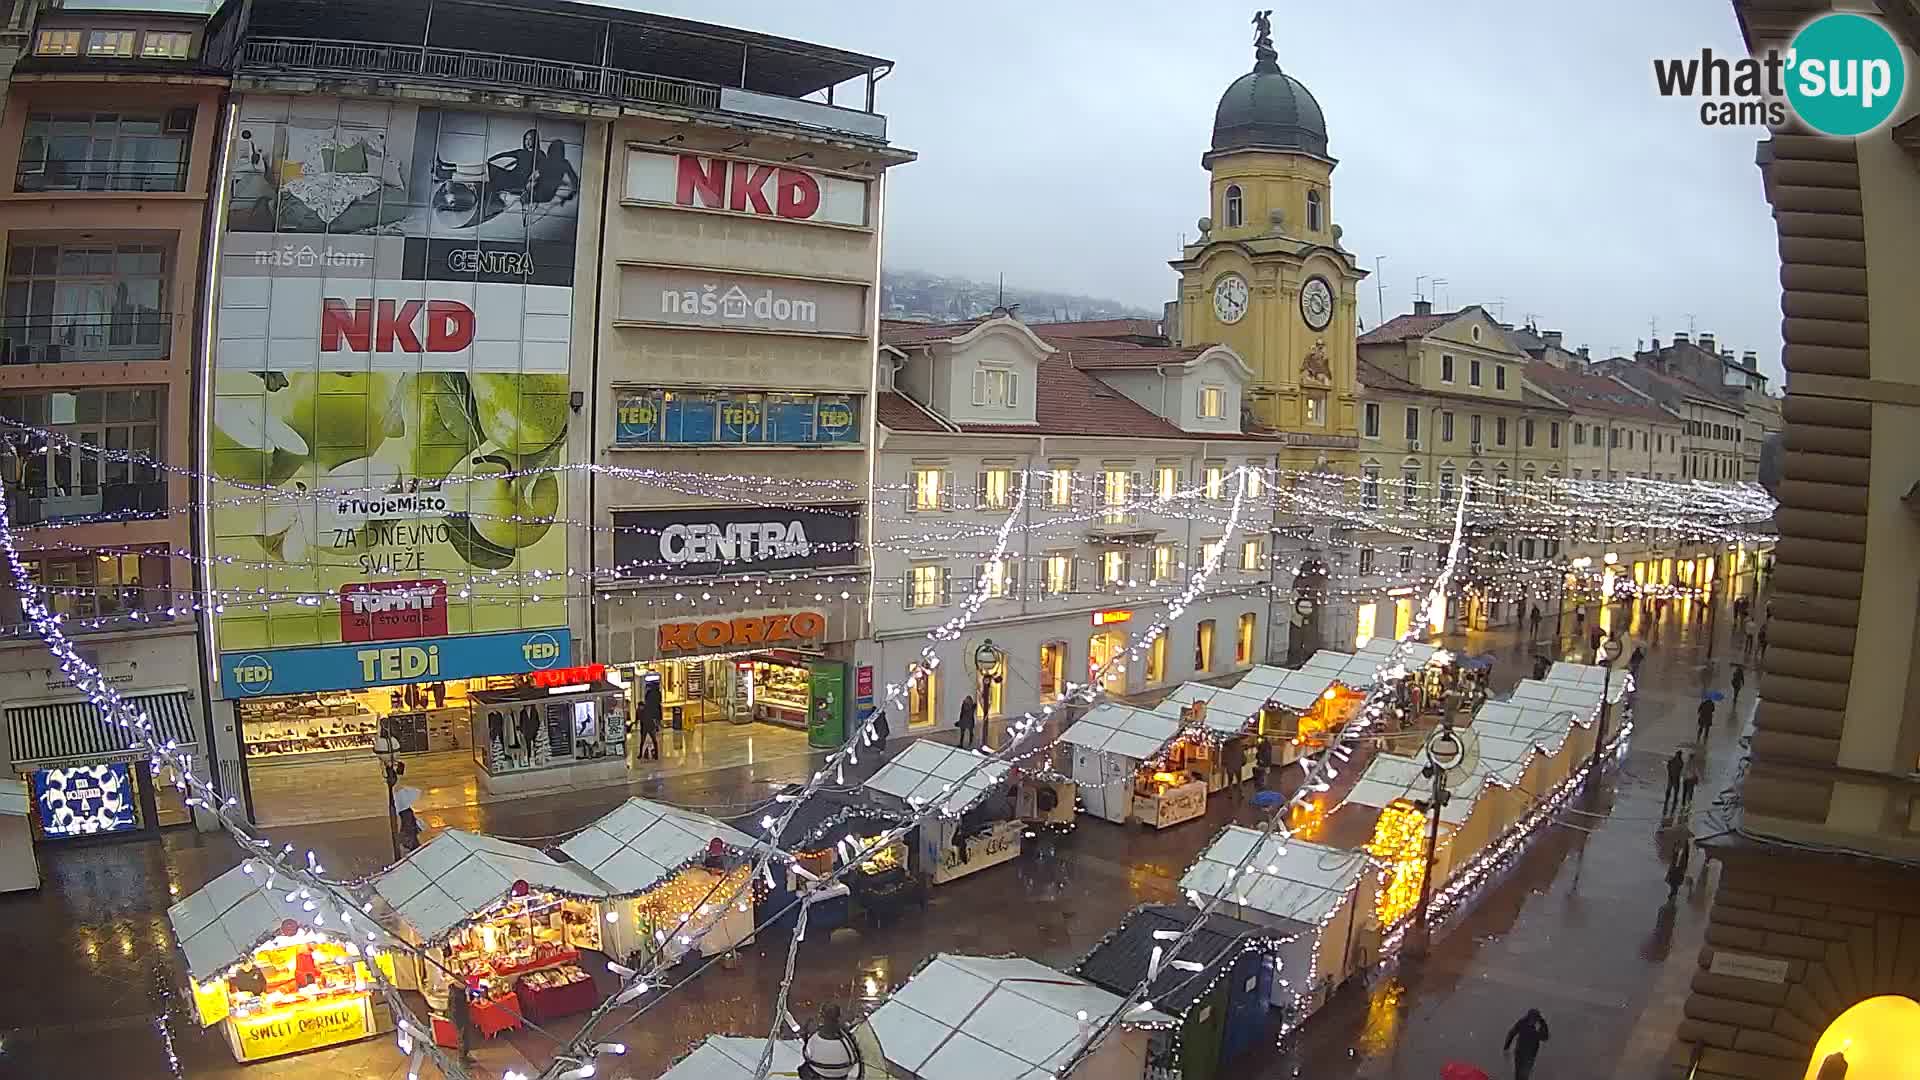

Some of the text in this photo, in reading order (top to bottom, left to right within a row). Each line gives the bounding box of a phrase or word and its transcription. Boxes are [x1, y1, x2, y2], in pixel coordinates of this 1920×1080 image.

[675, 155, 821, 220] NKD
[254, 244, 365, 268] naš dom
[447, 248, 535, 275] CENTRA
[661, 283, 817, 323] naš dom
[320, 297, 476, 353] NKD
[337, 496, 446, 516] #TvojeMisto
[333, 523, 450, 549] ZA DNEVNO
[659, 520, 811, 564] CENTRA
[359, 547, 425, 575] SVJEŽE
[658, 612, 825, 652] KORZO
[357, 644, 441, 683] TEDi
[522, 642, 561, 661] TEDi
[233, 665, 273, 684] TEDi
[249, 1022, 292, 1041] SWEET
